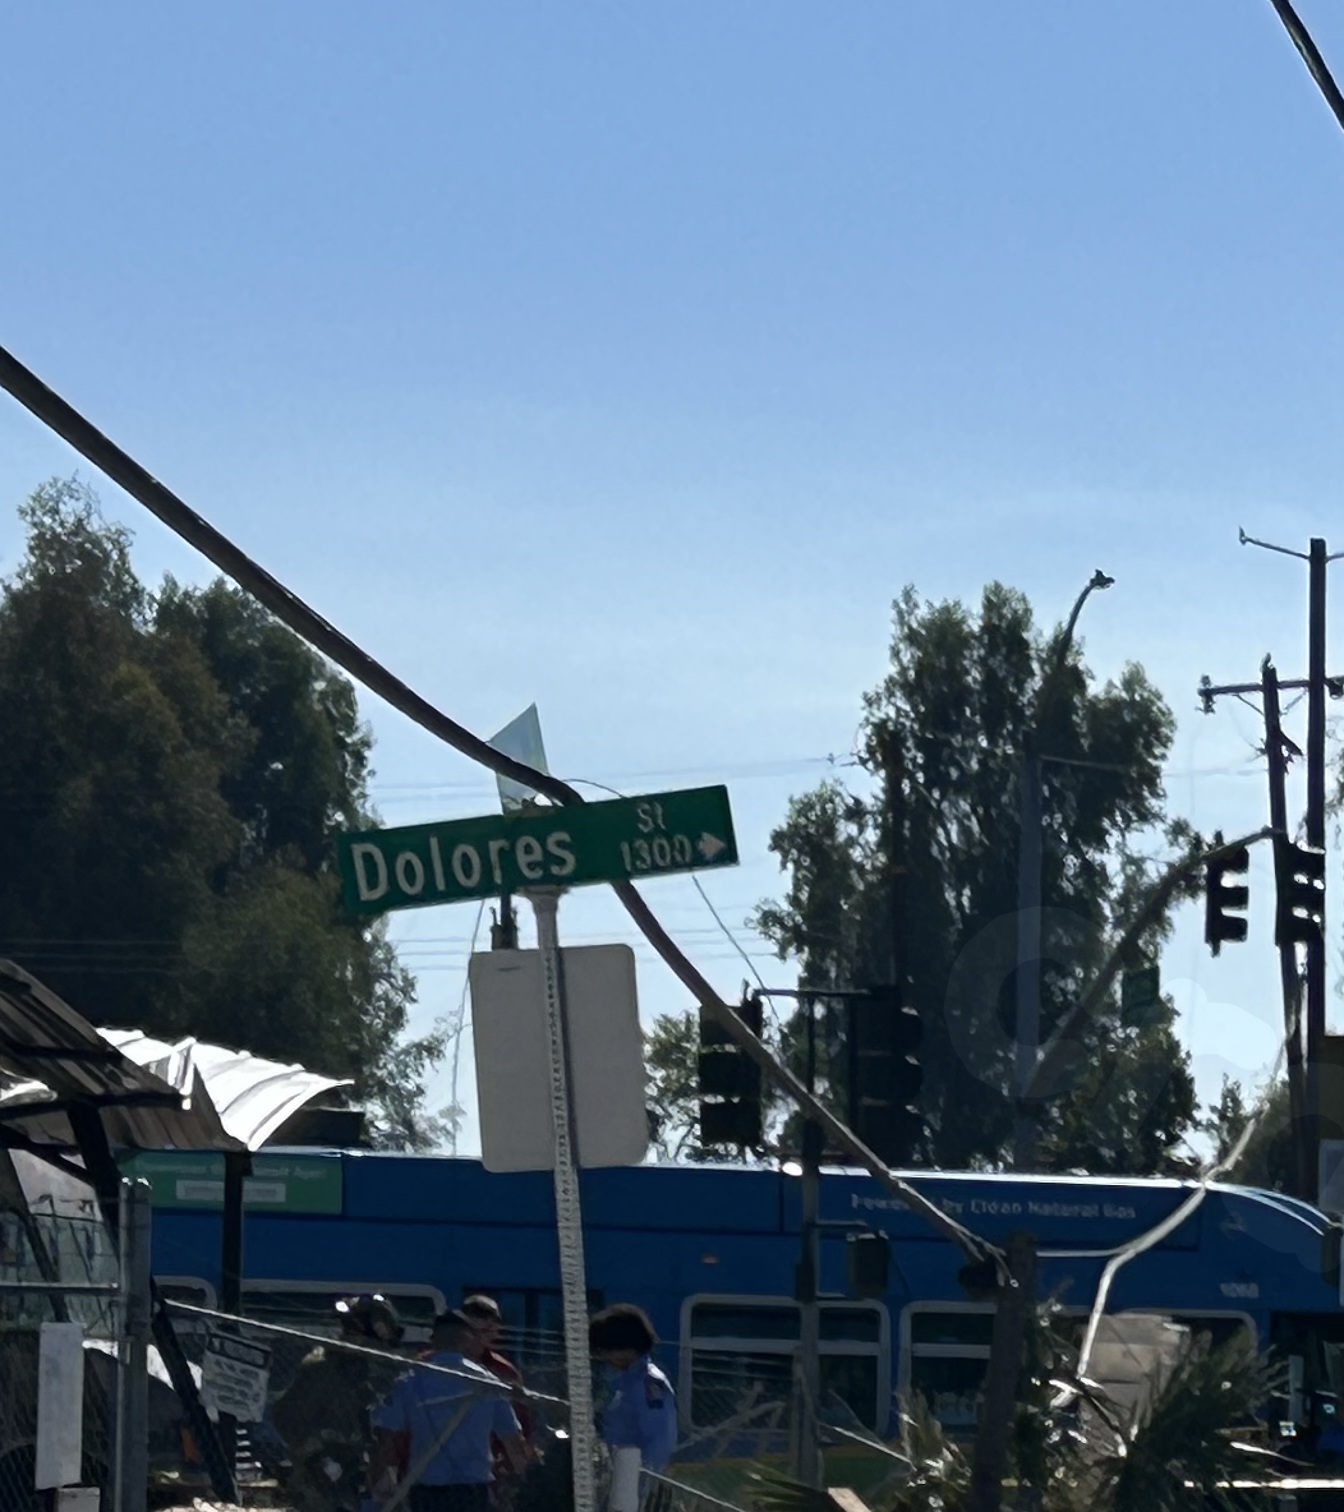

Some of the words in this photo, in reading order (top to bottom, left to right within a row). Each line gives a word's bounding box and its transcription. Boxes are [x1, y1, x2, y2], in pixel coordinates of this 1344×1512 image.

[637, 802, 667, 832] St
[351, 831, 577, 900] Dolores
[621, 834, 693, 871] 1300
